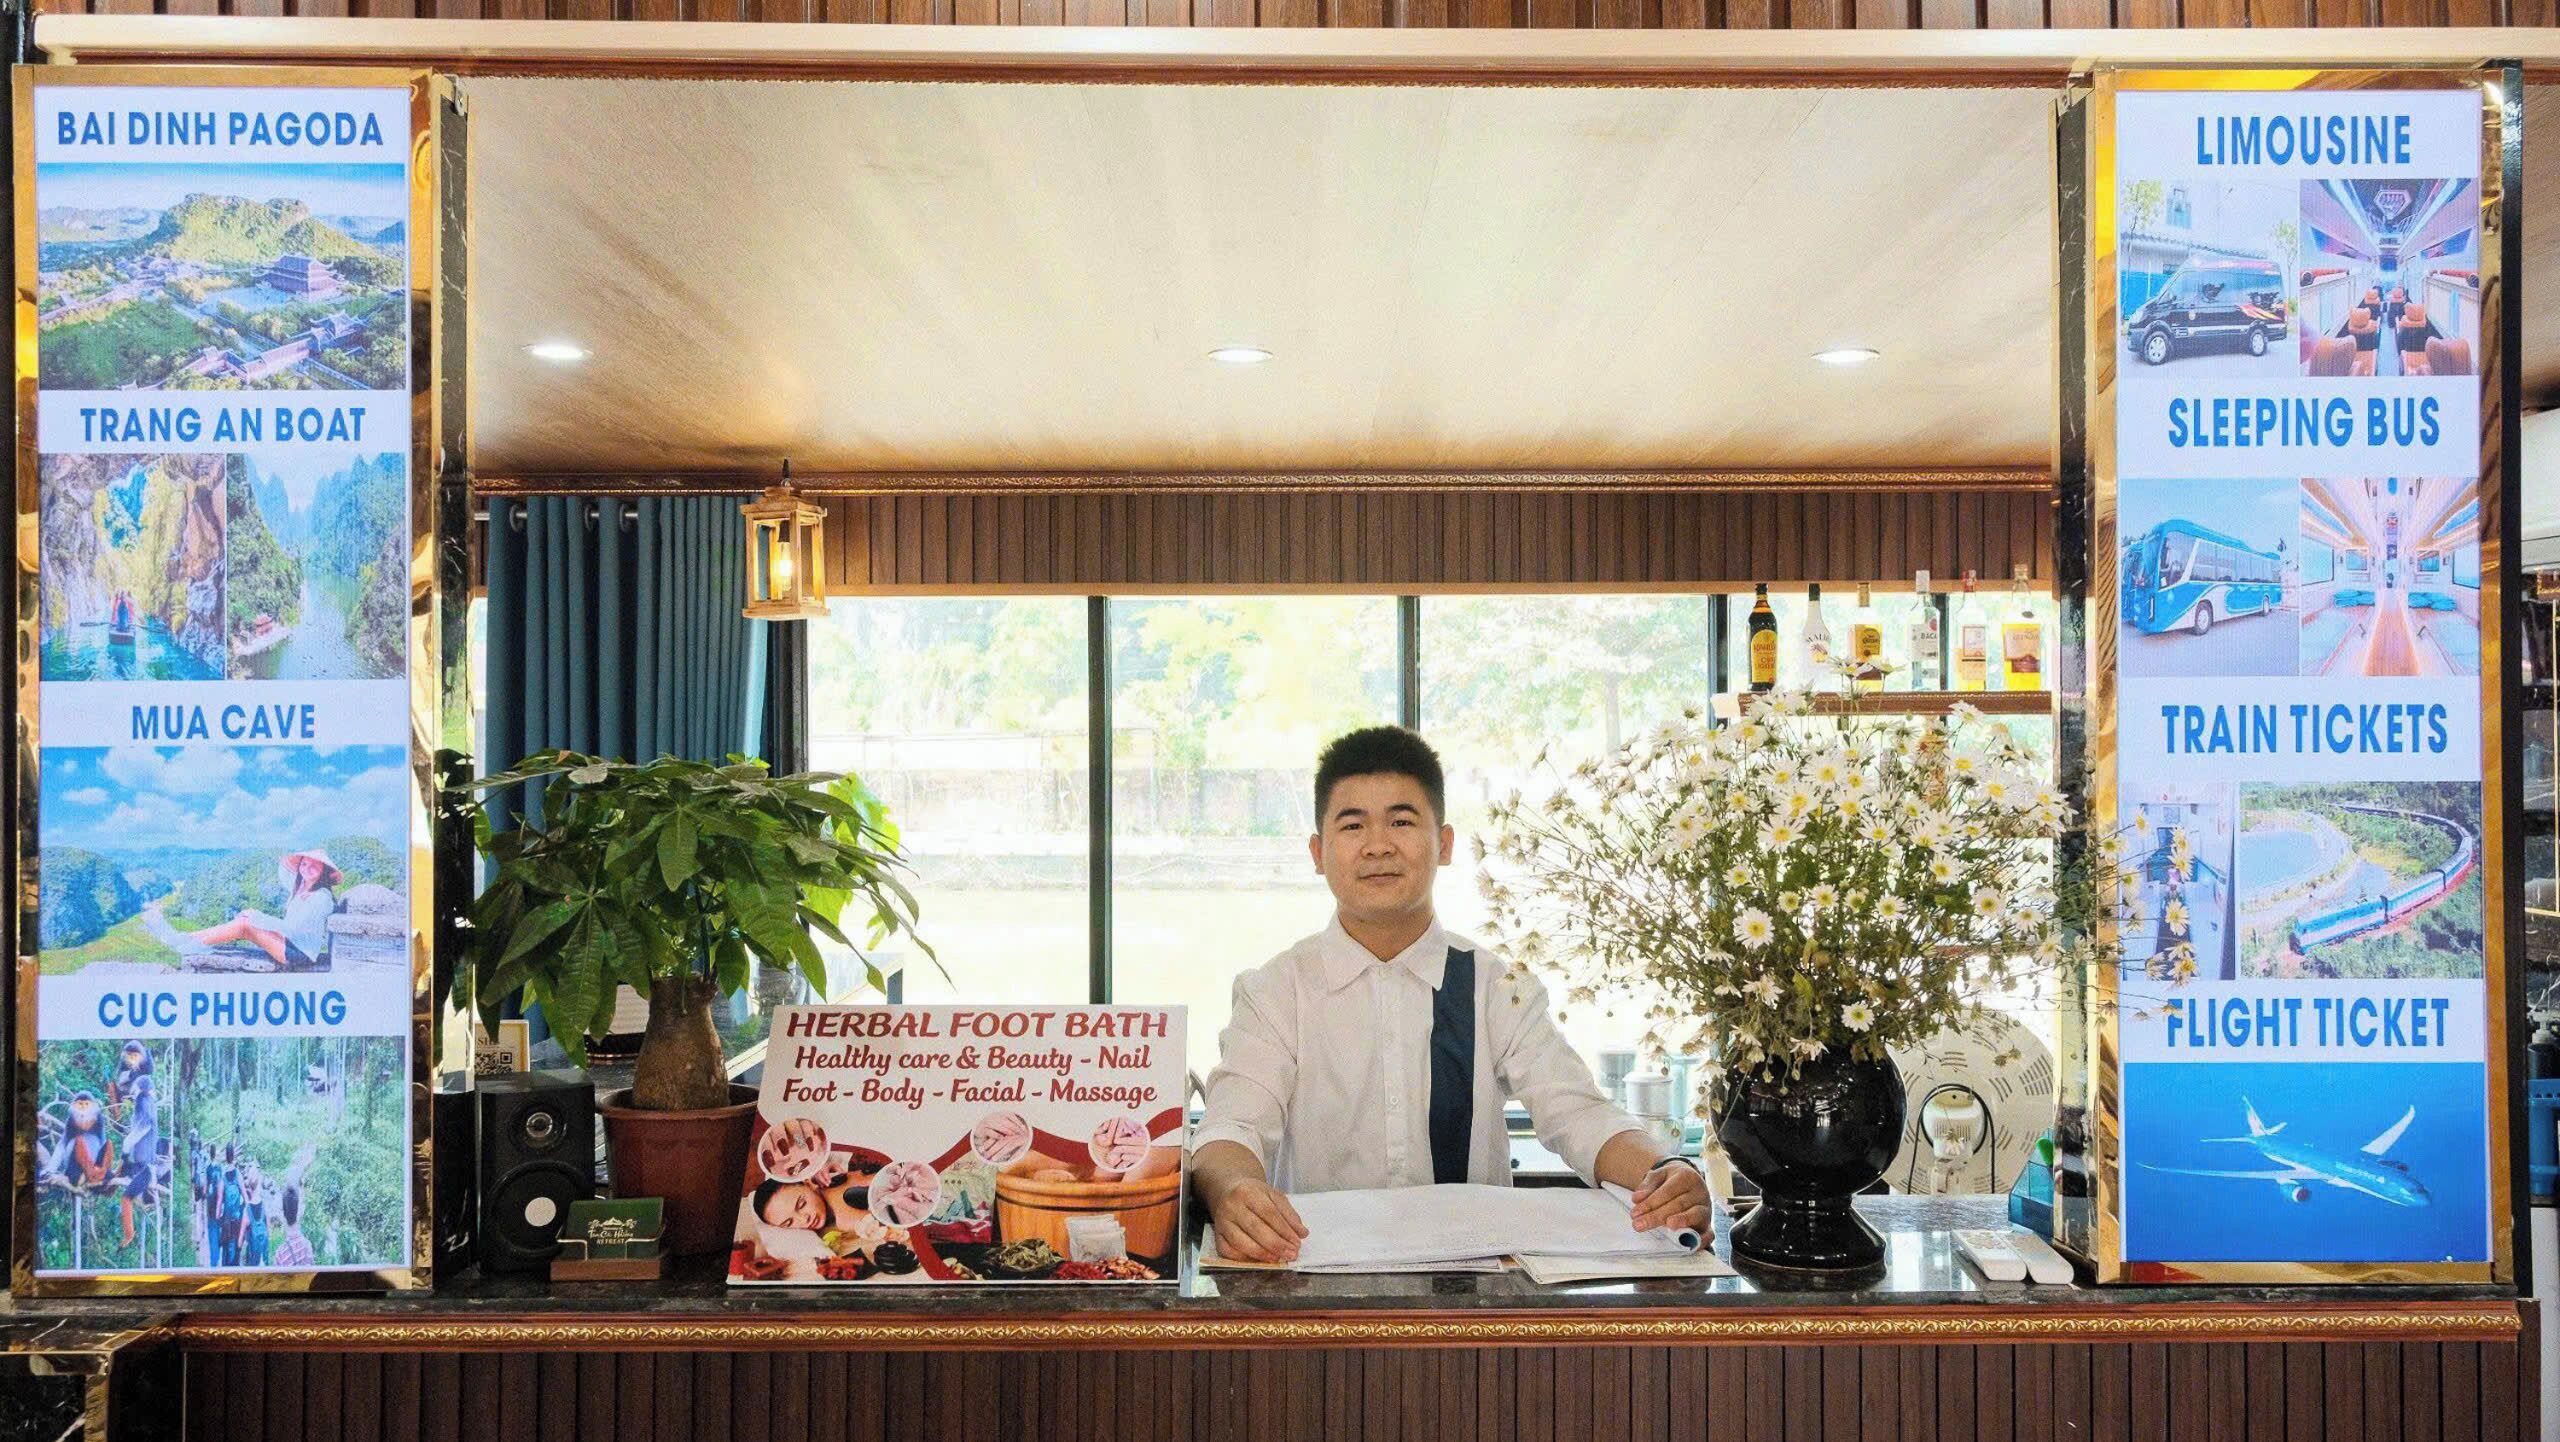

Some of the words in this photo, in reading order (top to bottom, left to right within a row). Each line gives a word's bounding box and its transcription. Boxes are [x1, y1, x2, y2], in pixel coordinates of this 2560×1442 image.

[58, 112, 116, 146] BAI
[129, 112, 217, 146] DINH
[229, 112, 384, 147] PAGODA
[2198, 115, 2411, 166] LIMOUSINE
[80, 408, 202, 443] TRANG
[214, 408, 264, 443] AN
[276, 407, 367, 443] BOAT
[2169, 397, 2354, 449] SLEEPING
[2368, 396, 2441, 448] BUS
[132, 705, 209, 741] MUA
[221, 704, 316, 741] CAVE
[2162, 704, 2278, 755] TRAIN
[2290, 704, 2449, 755] TICKETS
[98, 992, 178, 1028] CUC
[190, 990, 348, 1027] PHUONG
[786, 1012, 940, 1038] HERBAL
[949, 1012, 1056, 1038] FOOT
[1064, 1012, 1168, 1038] BATH
[2167, 997, 2303, 1049] FLIGHT
[2313, 997, 2450, 1049] TICKET
[794, 1044, 891, 1076] Healthy
[898, 1052, 952, 1069] care
[955, 1045, 982, 1069] &
[987, 1046, 1073, 1076] Beauty
[1098, 1044, 1152, 1069] Nail
[782, 1078, 838, 1102] Foot
[861, 1077, 925, 1110] Body
[950, 1077, 1026, 1102] Facial
[1049, 1078, 1158, 1110] Massage
